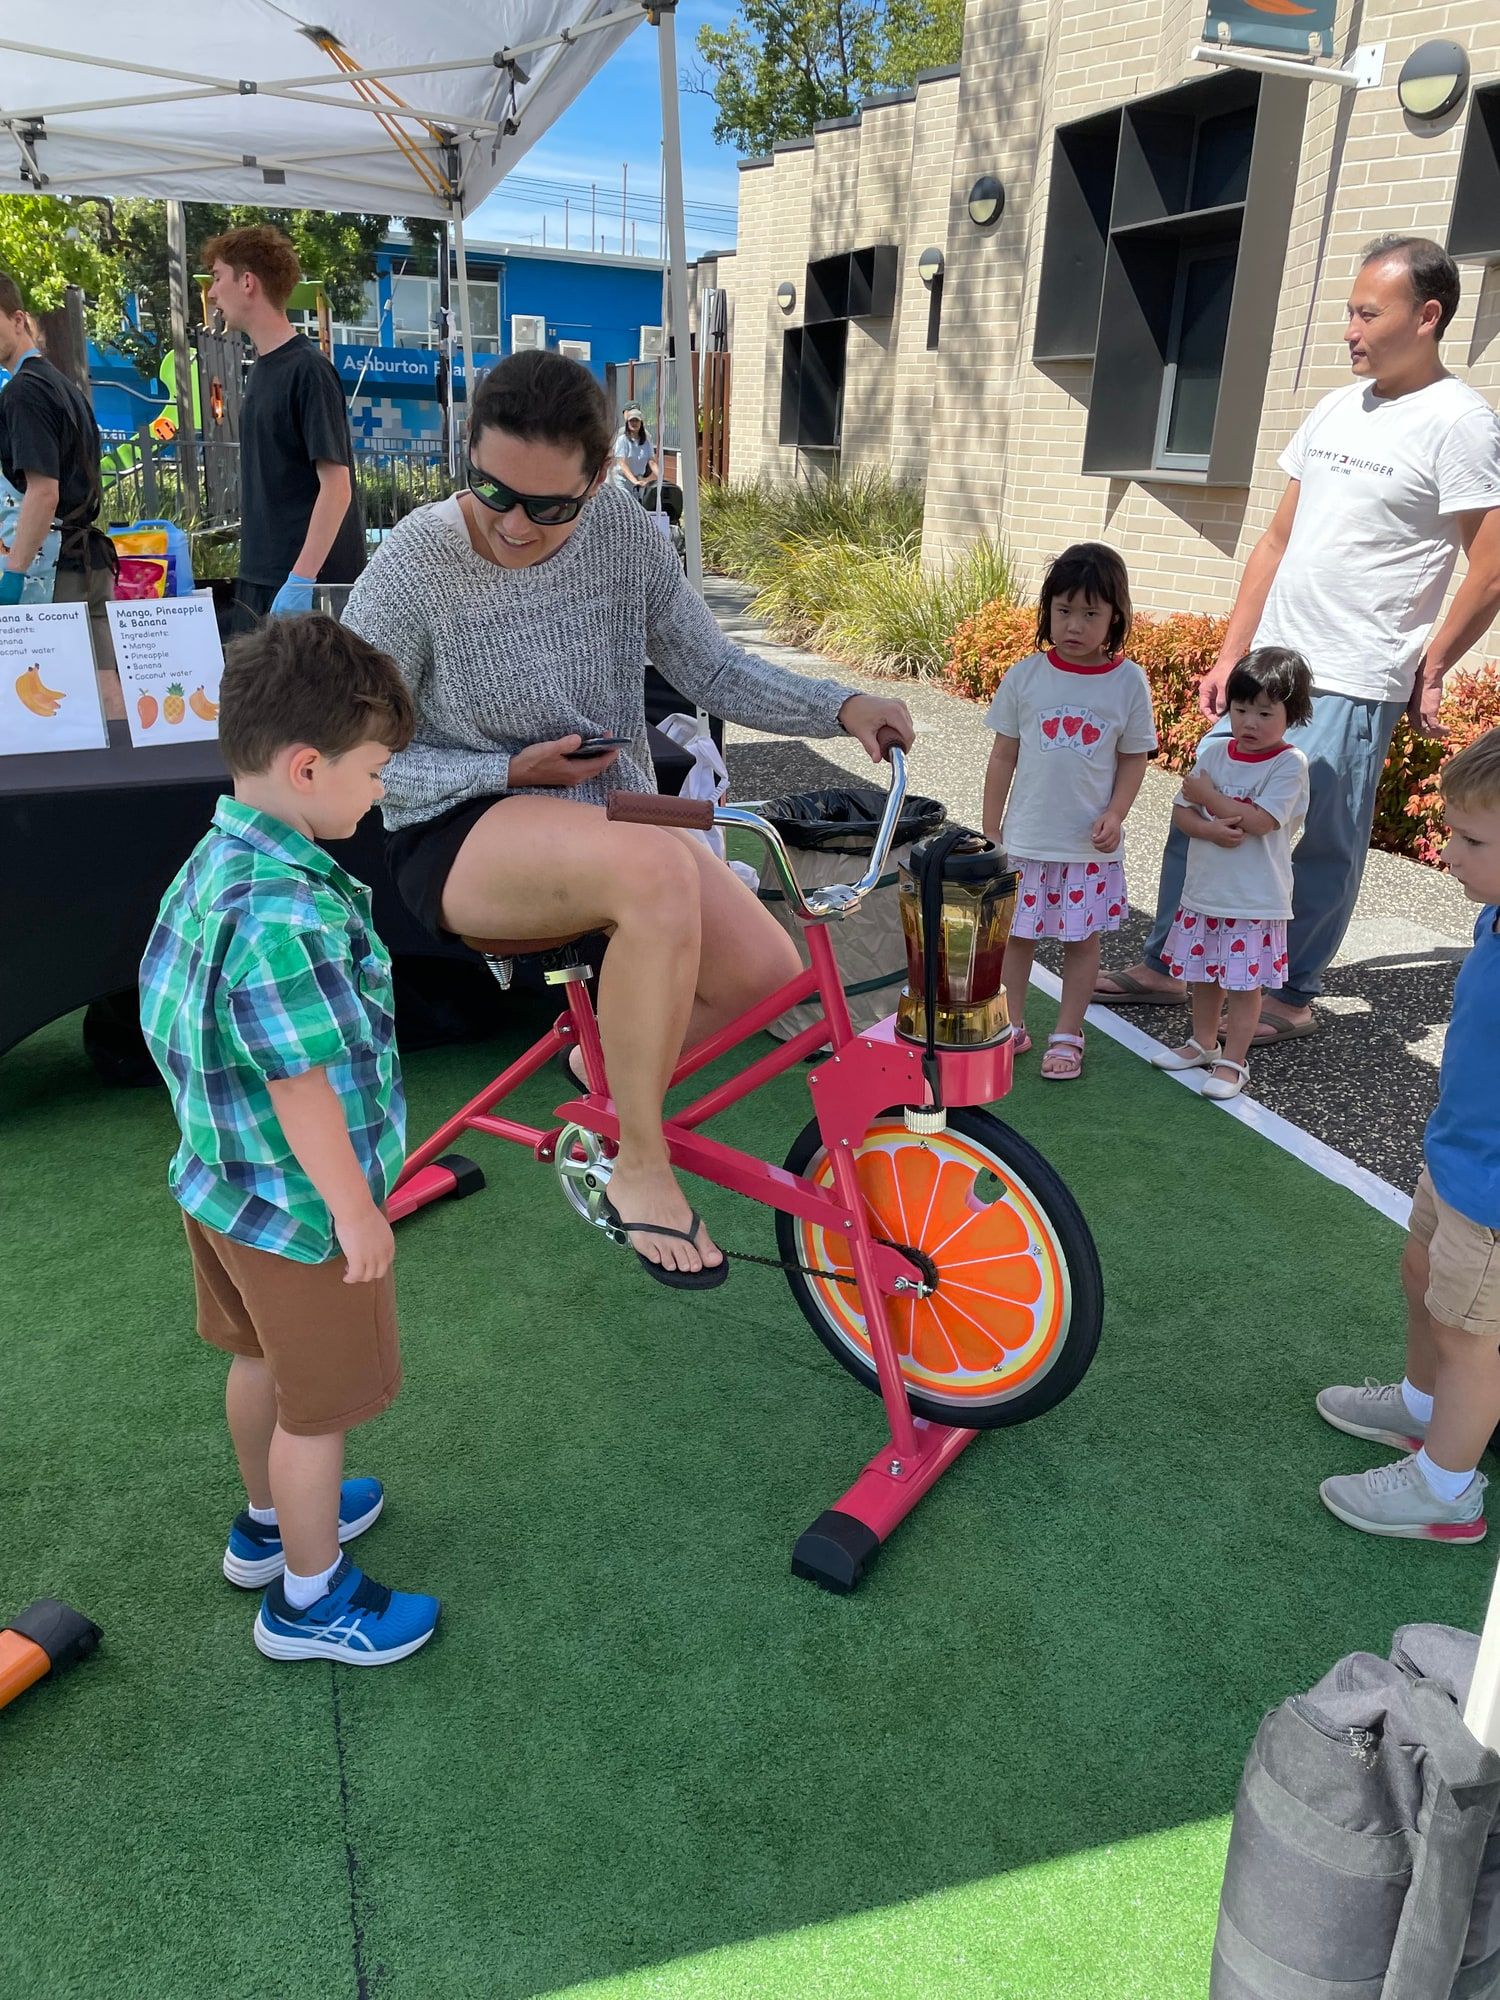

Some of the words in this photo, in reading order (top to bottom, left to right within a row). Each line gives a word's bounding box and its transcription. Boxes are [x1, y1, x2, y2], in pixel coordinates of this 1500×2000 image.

[343, 355, 428, 375] Ashburton
[1307, 448, 1339, 461] TOMMY
[1349, 457, 1394, 477] HILFIGER
[25, 613, 33, 621] &
[38, 611, 79, 621] Coconut
[116, 609, 152, 619] Mango,
[156, 604, 204, 616] Pineapple
[119, 620, 127, 628] &
[131, 618, 167, 628] Banana
[120, 630, 169, 641] Ingredients:
[129, 642, 156, 651] Mango
[131, 651, 169, 660] Pineapple
[133, 662, 162, 670] Banana
[135, 672, 166, 681] Coconut
[170, 670, 192, 678] water
